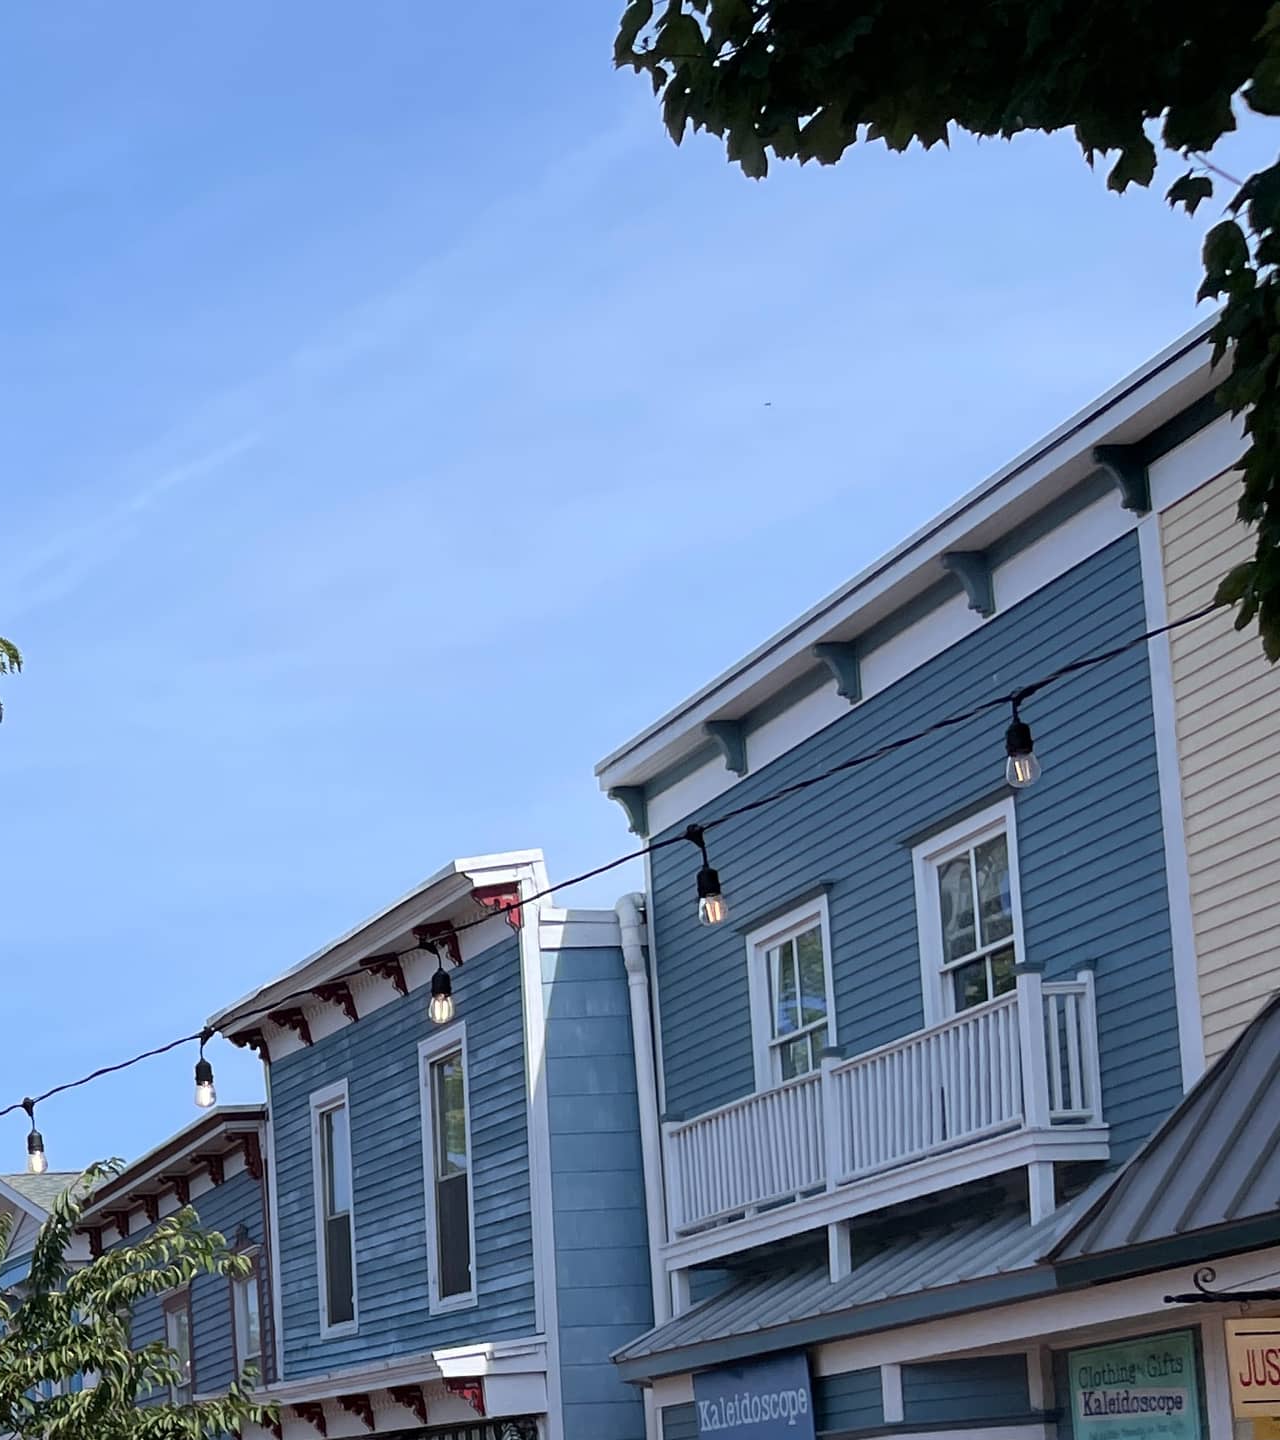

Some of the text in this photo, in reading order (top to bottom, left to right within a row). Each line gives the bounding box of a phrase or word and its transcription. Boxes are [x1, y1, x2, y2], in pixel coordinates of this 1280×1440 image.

[1078, 1363, 1137, 1389] Clothing
[1146, 1352, 1183, 1378] Gifts
[698, 1388, 808, 1432] Kaleidoscope
[1082, 1390, 1183, 1416] Kaleidoscope
